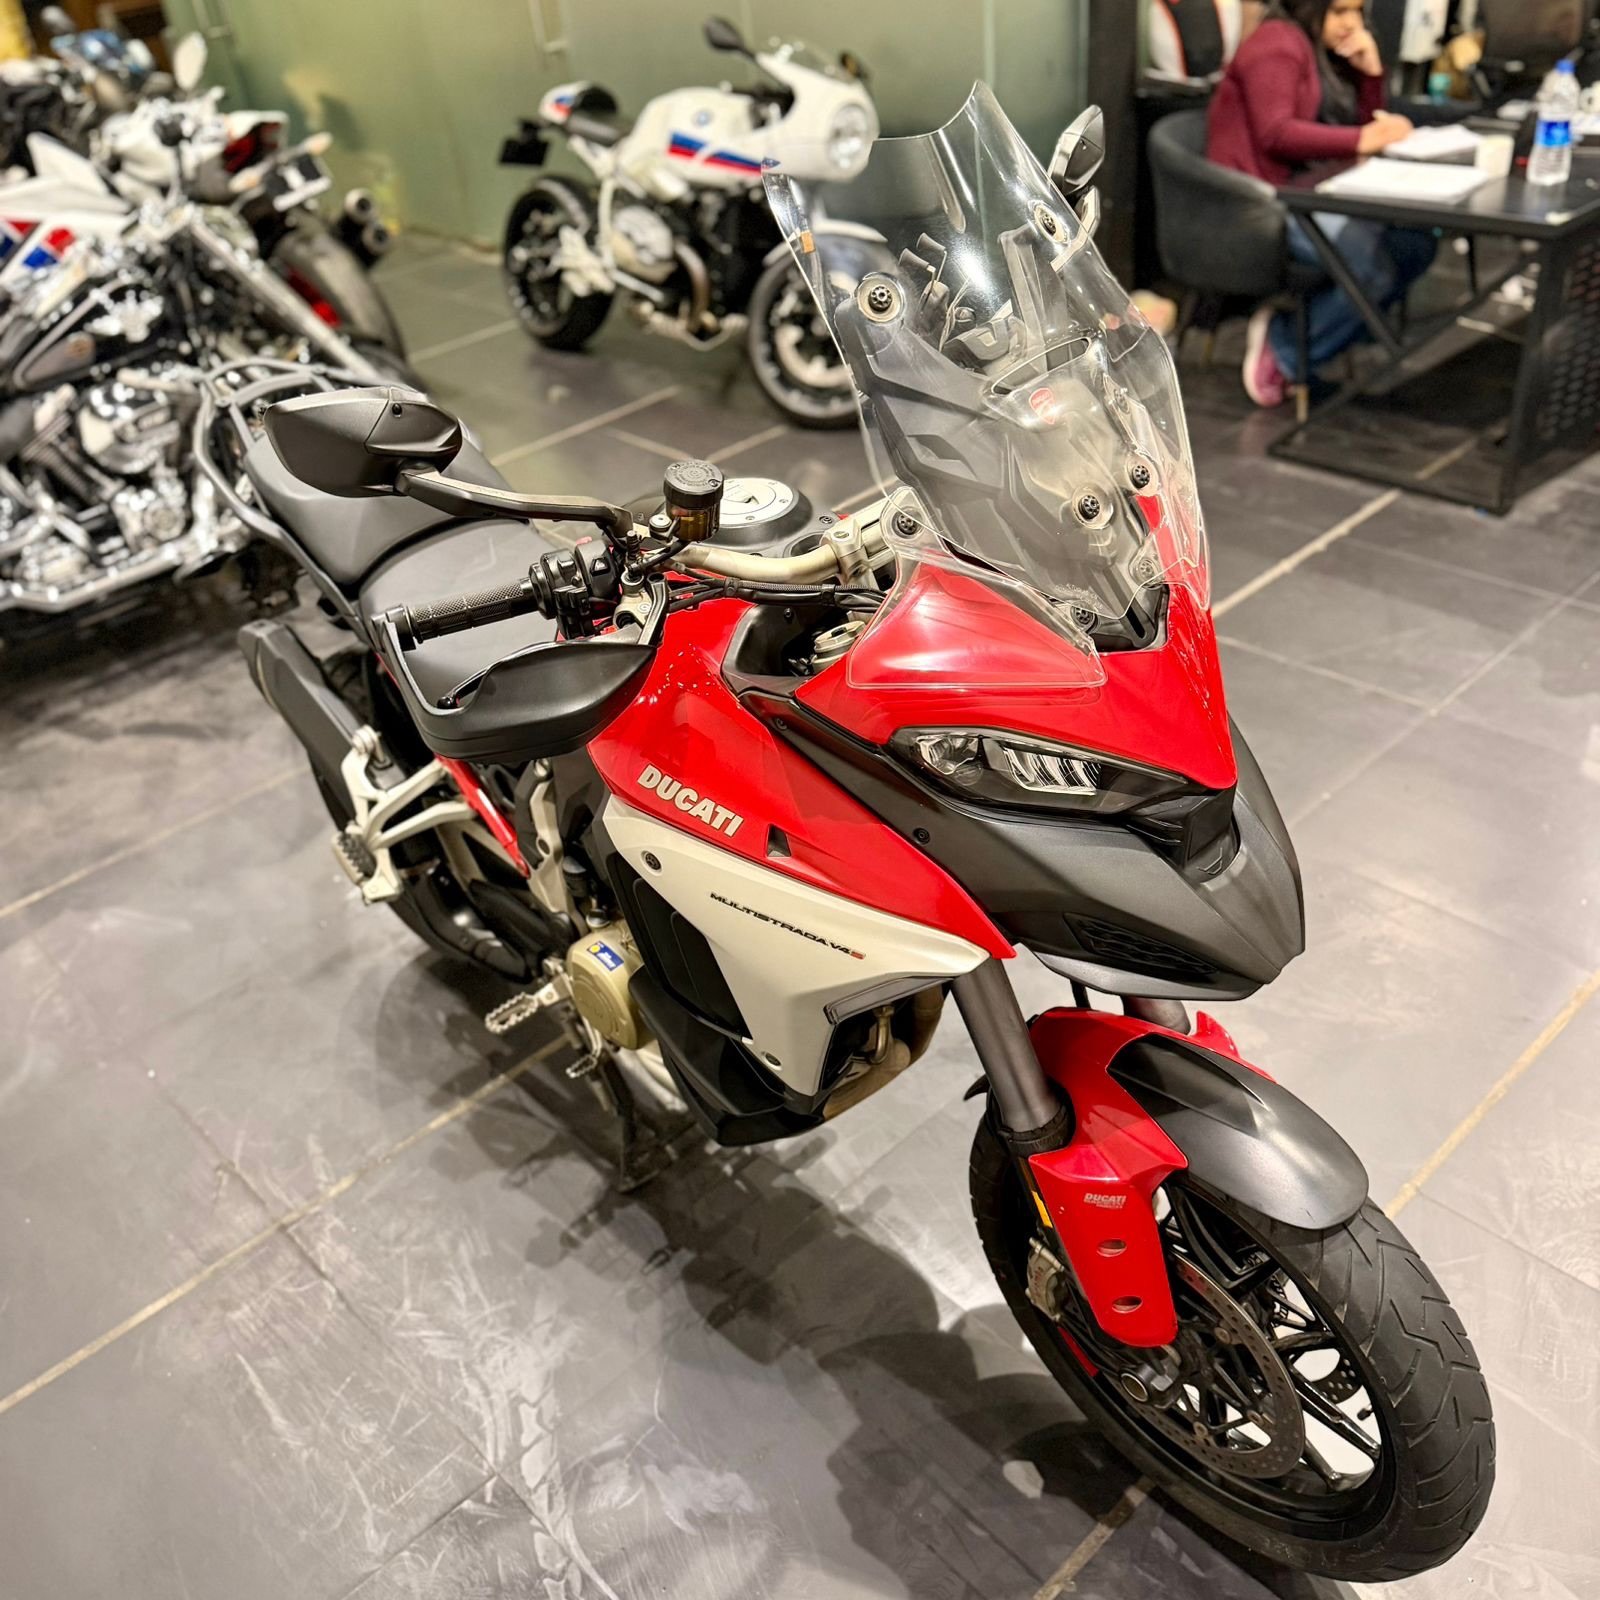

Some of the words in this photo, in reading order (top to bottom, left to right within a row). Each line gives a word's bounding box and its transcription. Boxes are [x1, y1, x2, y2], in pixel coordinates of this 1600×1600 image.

[637, 764, 744, 837] DUCATI
[710, 892, 829, 946] MULTISTRADA
[1084, 1193, 1127, 1202] DUCATI
